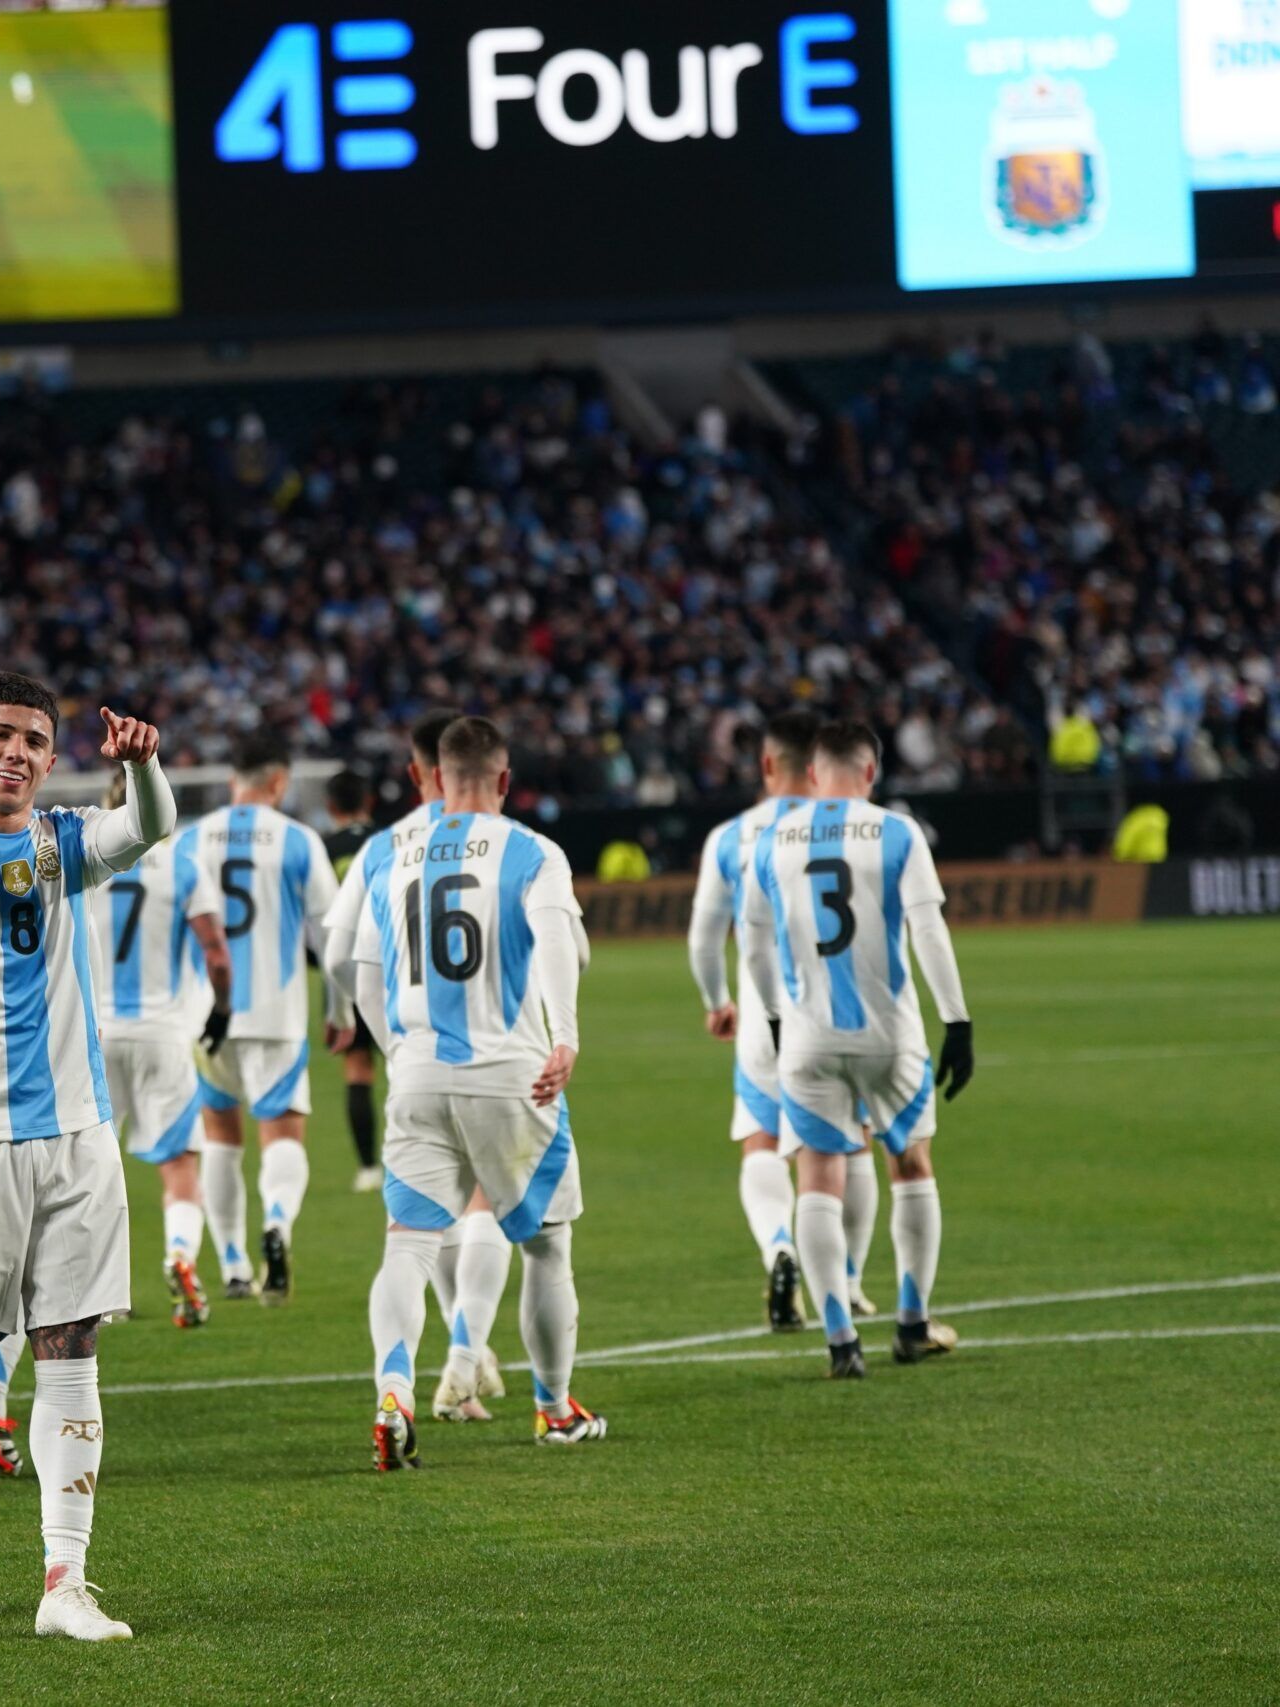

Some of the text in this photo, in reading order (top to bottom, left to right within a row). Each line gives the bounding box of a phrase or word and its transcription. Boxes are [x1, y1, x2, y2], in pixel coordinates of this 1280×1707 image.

[428, 840, 489, 862] CELSO
[776, 822, 883, 846] TAGLIAFICO
[9, 901, 40, 955] 8
[108, 881, 147, 963] 7
[221, 858, 257, 938] 5
[404, 873, 482, 987] 16
[804, 857, 857, 957] 3
